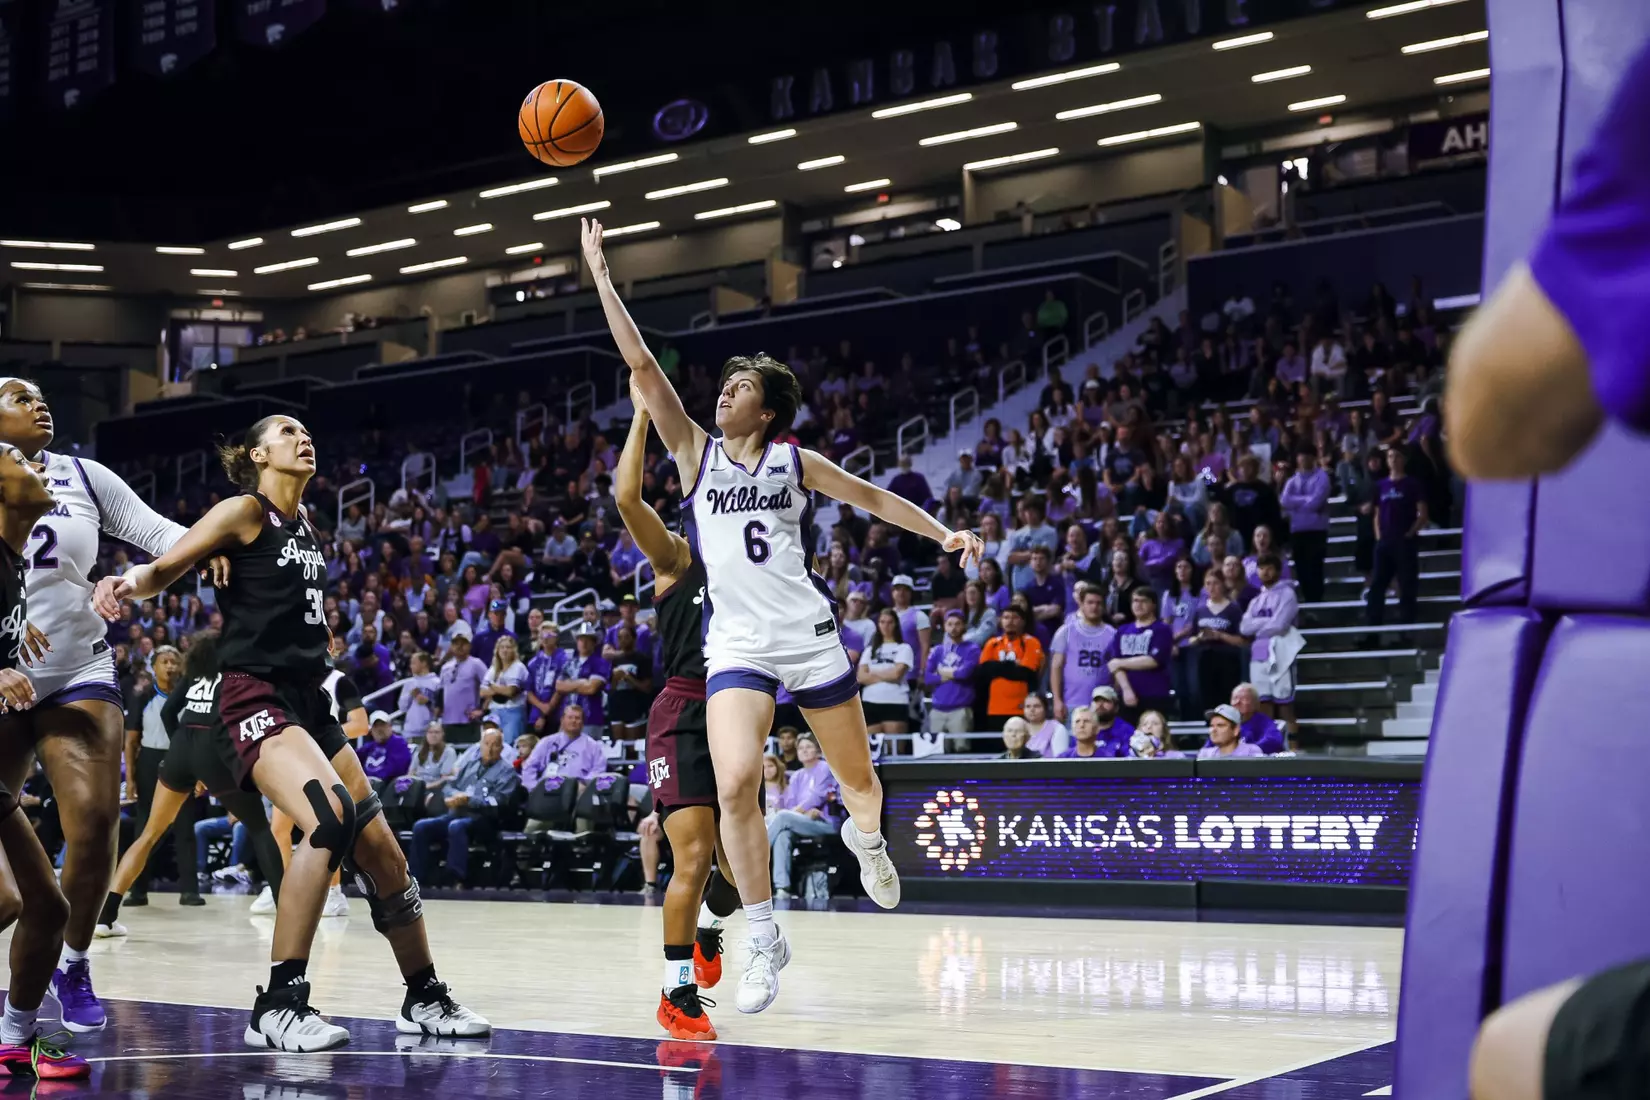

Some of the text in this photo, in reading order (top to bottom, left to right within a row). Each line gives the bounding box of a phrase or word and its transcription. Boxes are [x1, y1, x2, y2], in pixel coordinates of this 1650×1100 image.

[706, 485, 793, 515] Wildcats
[22, 524, 58, 569] 2
[277, 538, 327, 580] Aggie
[743, 520, 772, 566] 6
[998, 814, 1384, 850] KANSAS LOTTERY
